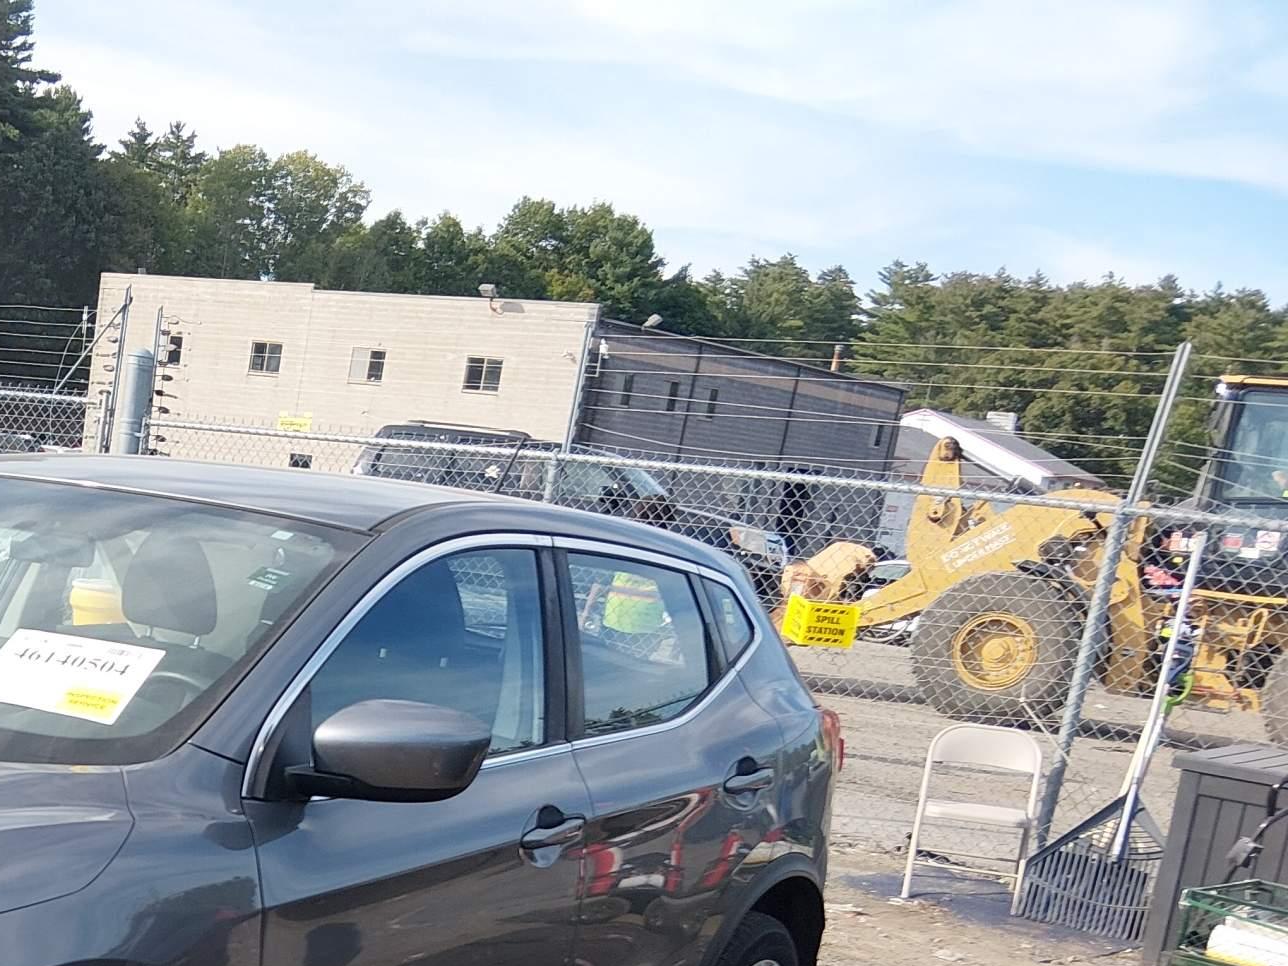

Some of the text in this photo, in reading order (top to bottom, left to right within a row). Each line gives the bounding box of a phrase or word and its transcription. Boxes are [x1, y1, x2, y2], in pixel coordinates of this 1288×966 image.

[815, 614, 841, 625] SPILL
[806, 626, 846, 637] STATION
[14, 647, 131, 676] 46140504
